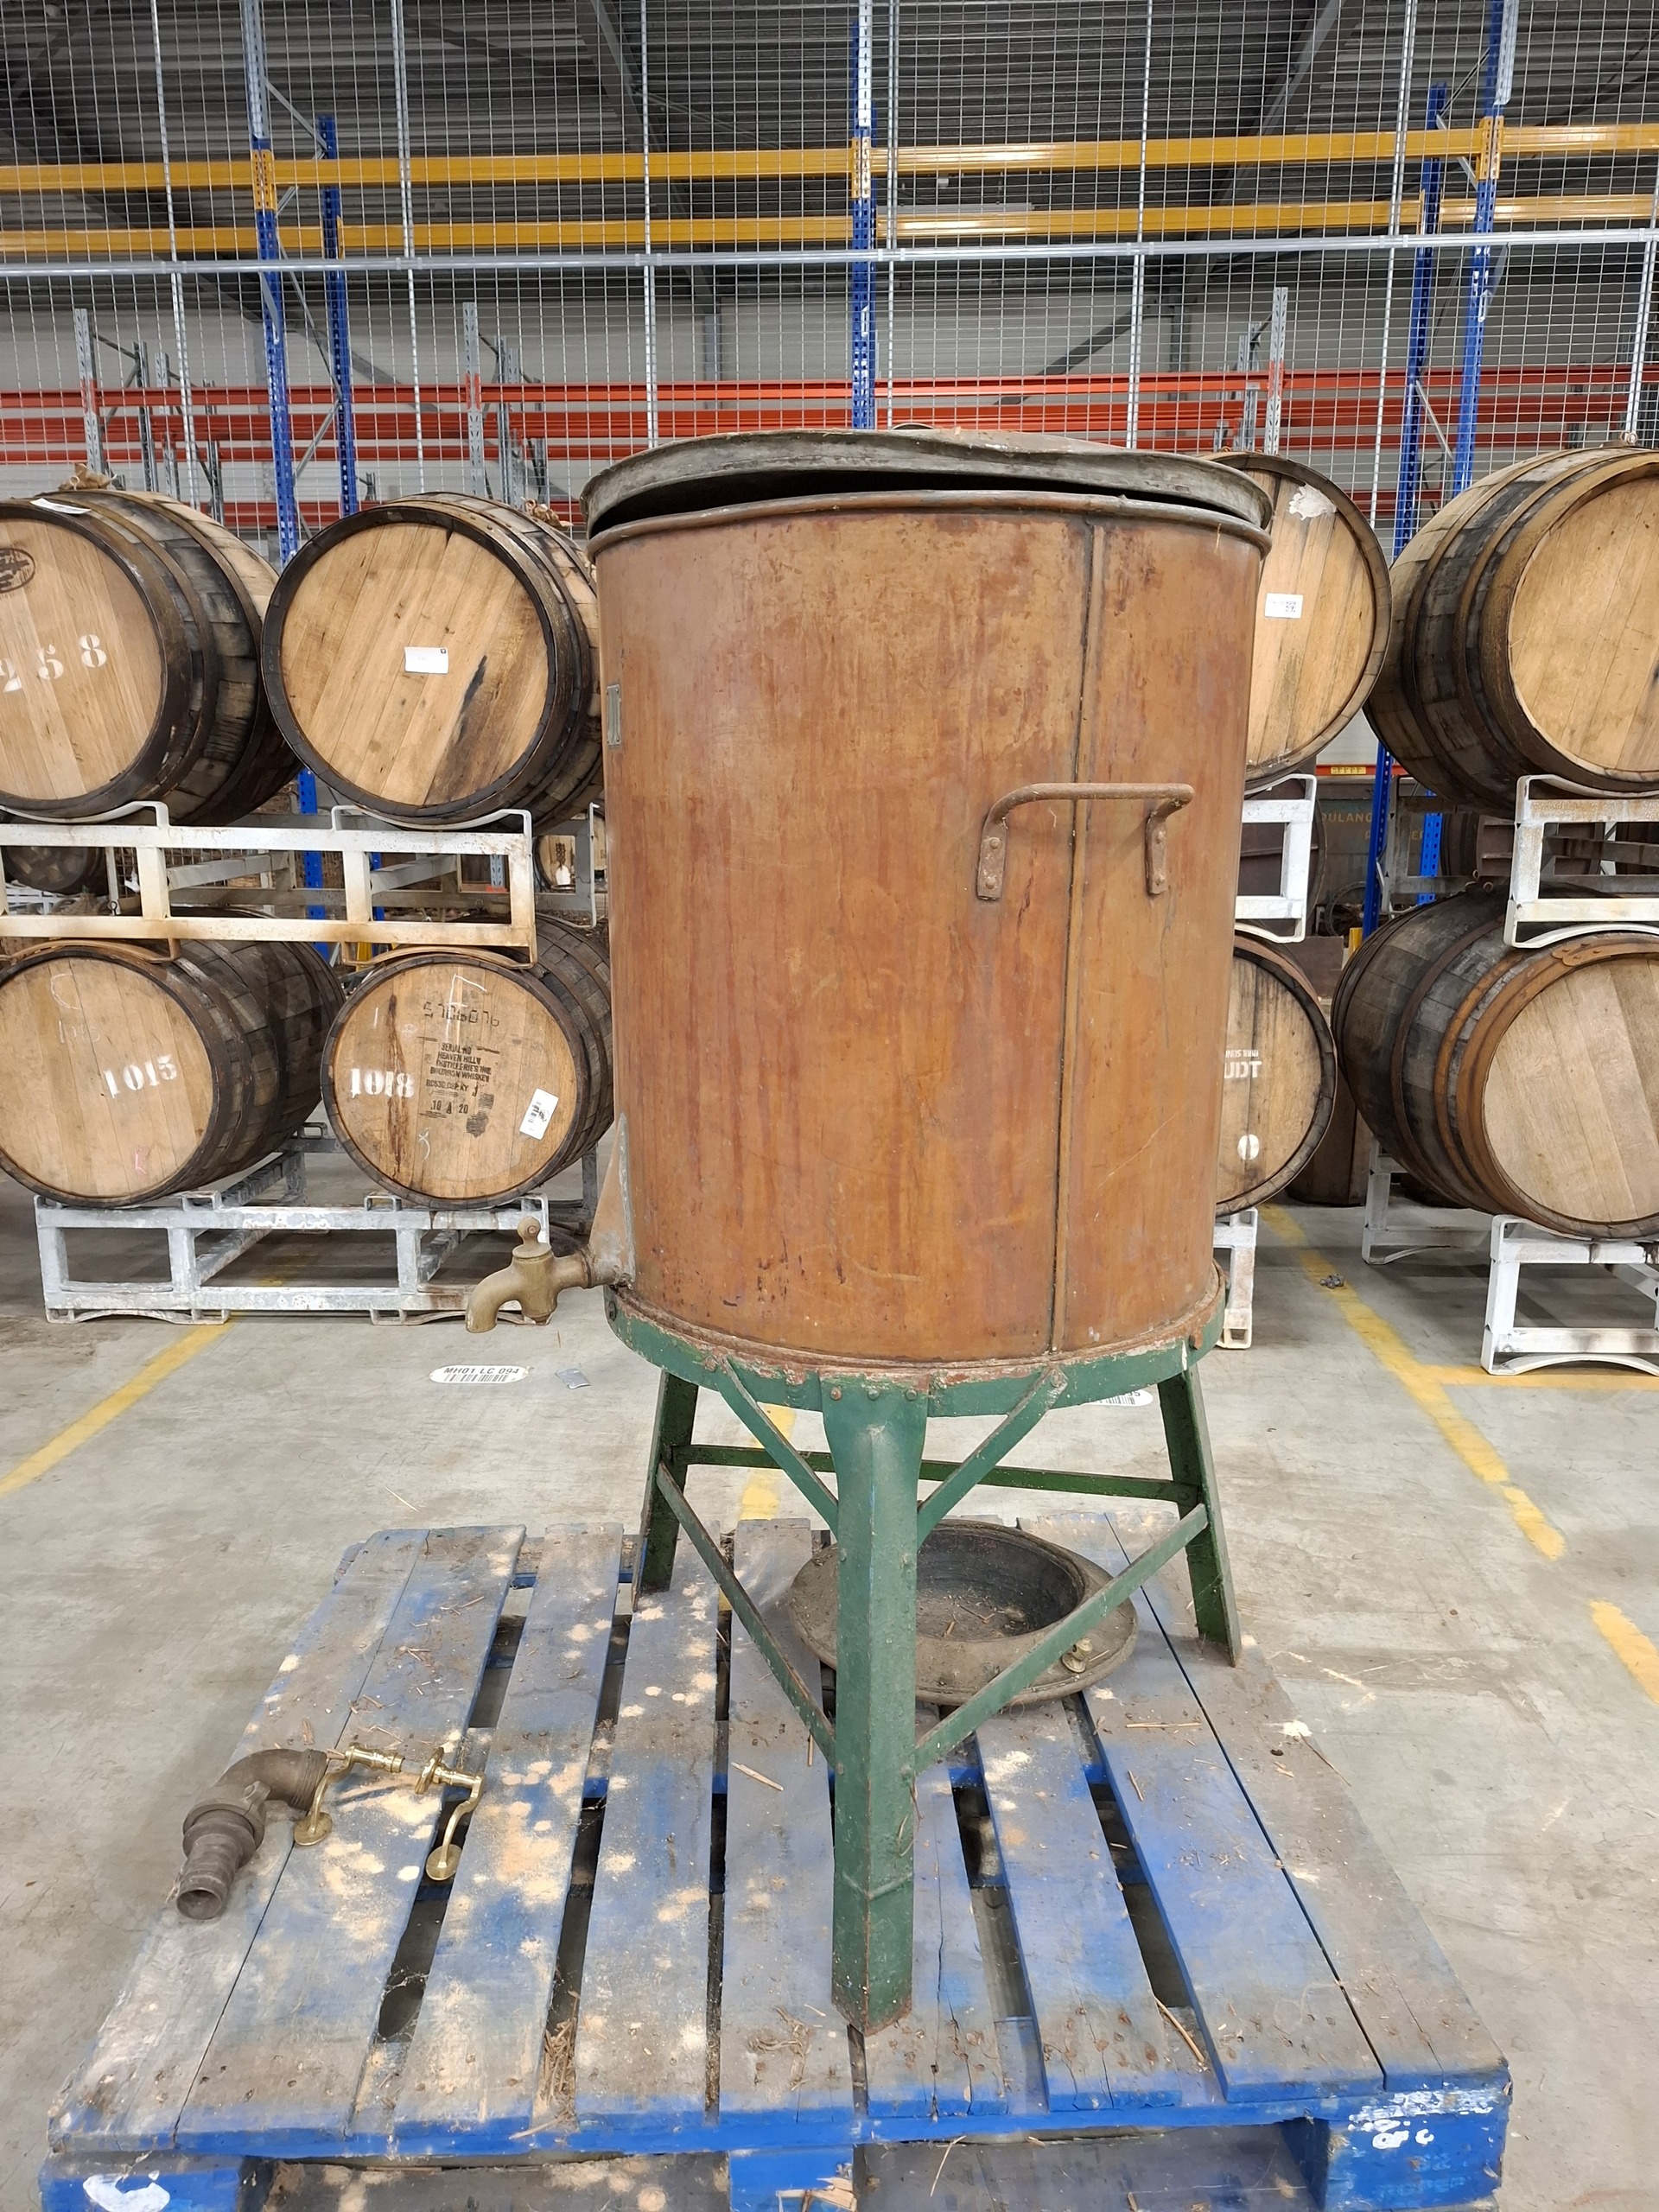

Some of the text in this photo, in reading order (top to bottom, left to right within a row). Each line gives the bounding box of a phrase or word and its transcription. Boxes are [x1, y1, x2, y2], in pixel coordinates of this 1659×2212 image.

[437, 1051, 462, 1062] HEAVEN
[103, 1054, 177, 1099] 1015
[461, 1071, 490, 1083] WHISKEY
[350, 1068, 415, 1098] 1018
[458, 1103, 469, 1115] 20
